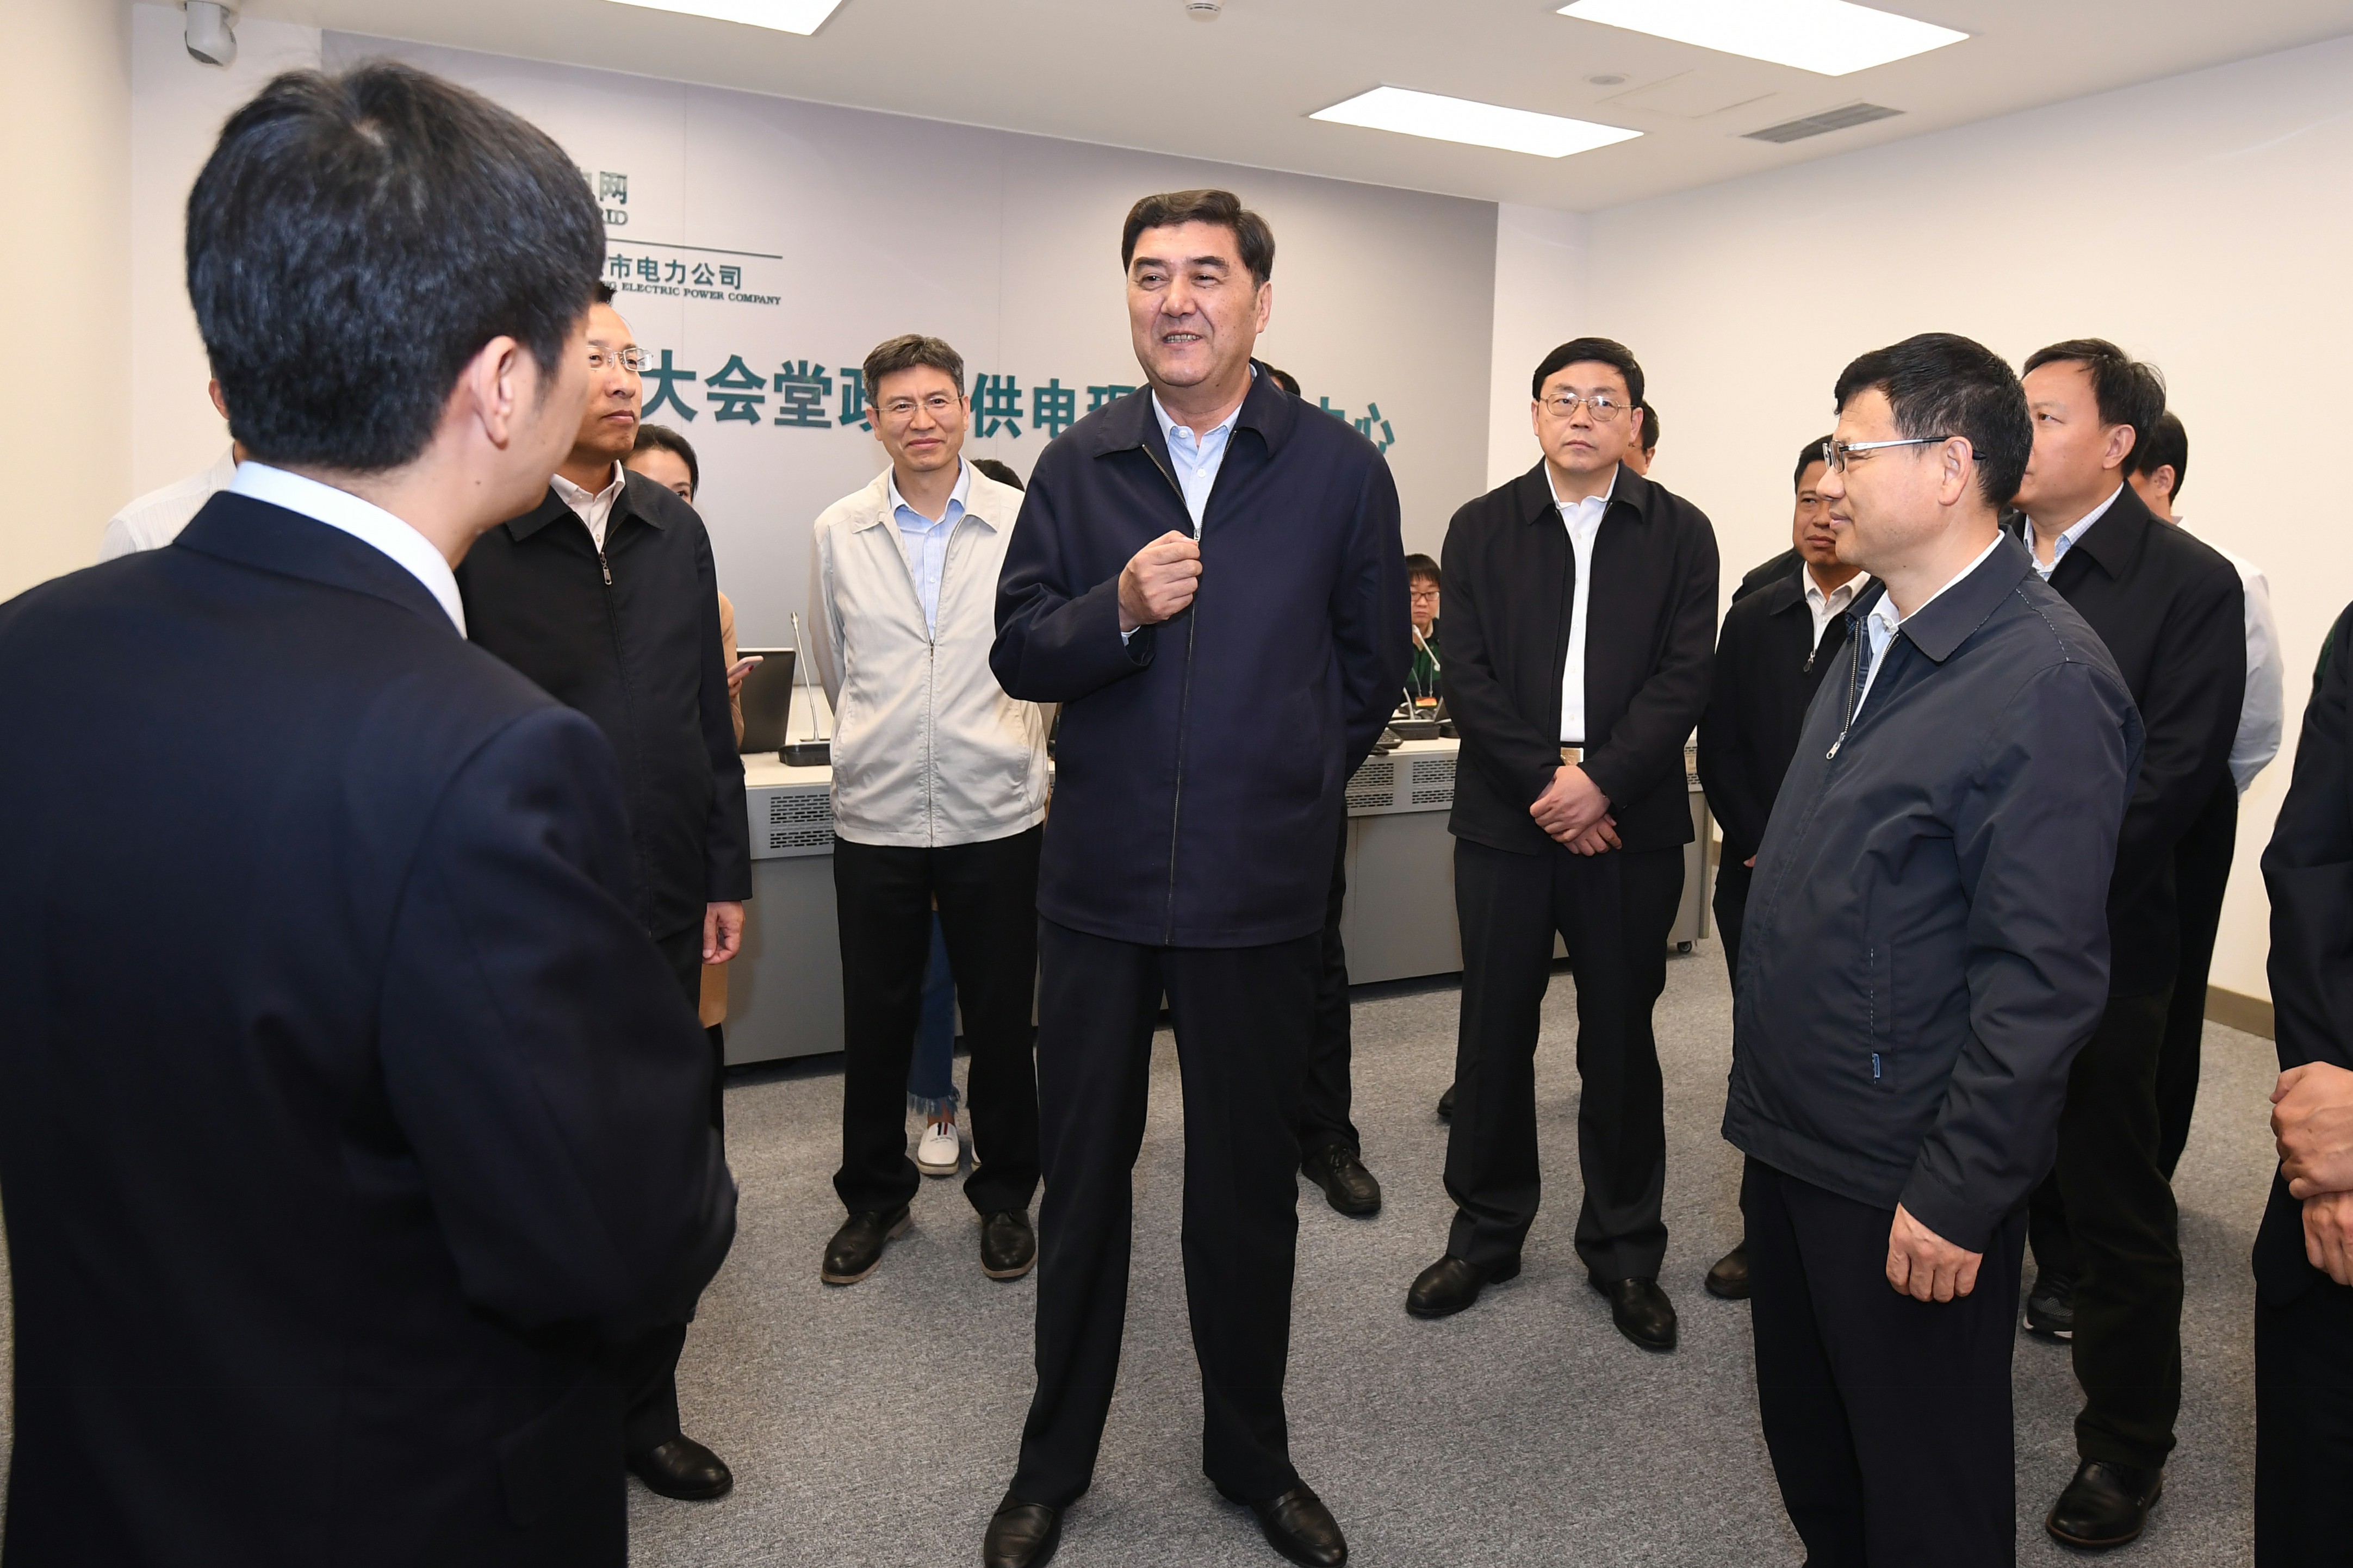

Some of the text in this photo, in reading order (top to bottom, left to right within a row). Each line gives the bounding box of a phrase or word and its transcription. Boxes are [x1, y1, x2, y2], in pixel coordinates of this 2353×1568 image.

[583, 171, 628, 205] 网
[603, 209, 628, 226] ID
[608, 253, 741, 290] 市电力公司
[622, 282, 680, 296] ELECTRIC
[684, 288, 724, 300] POWER
[728, 293, 781, 306] COMPANY
